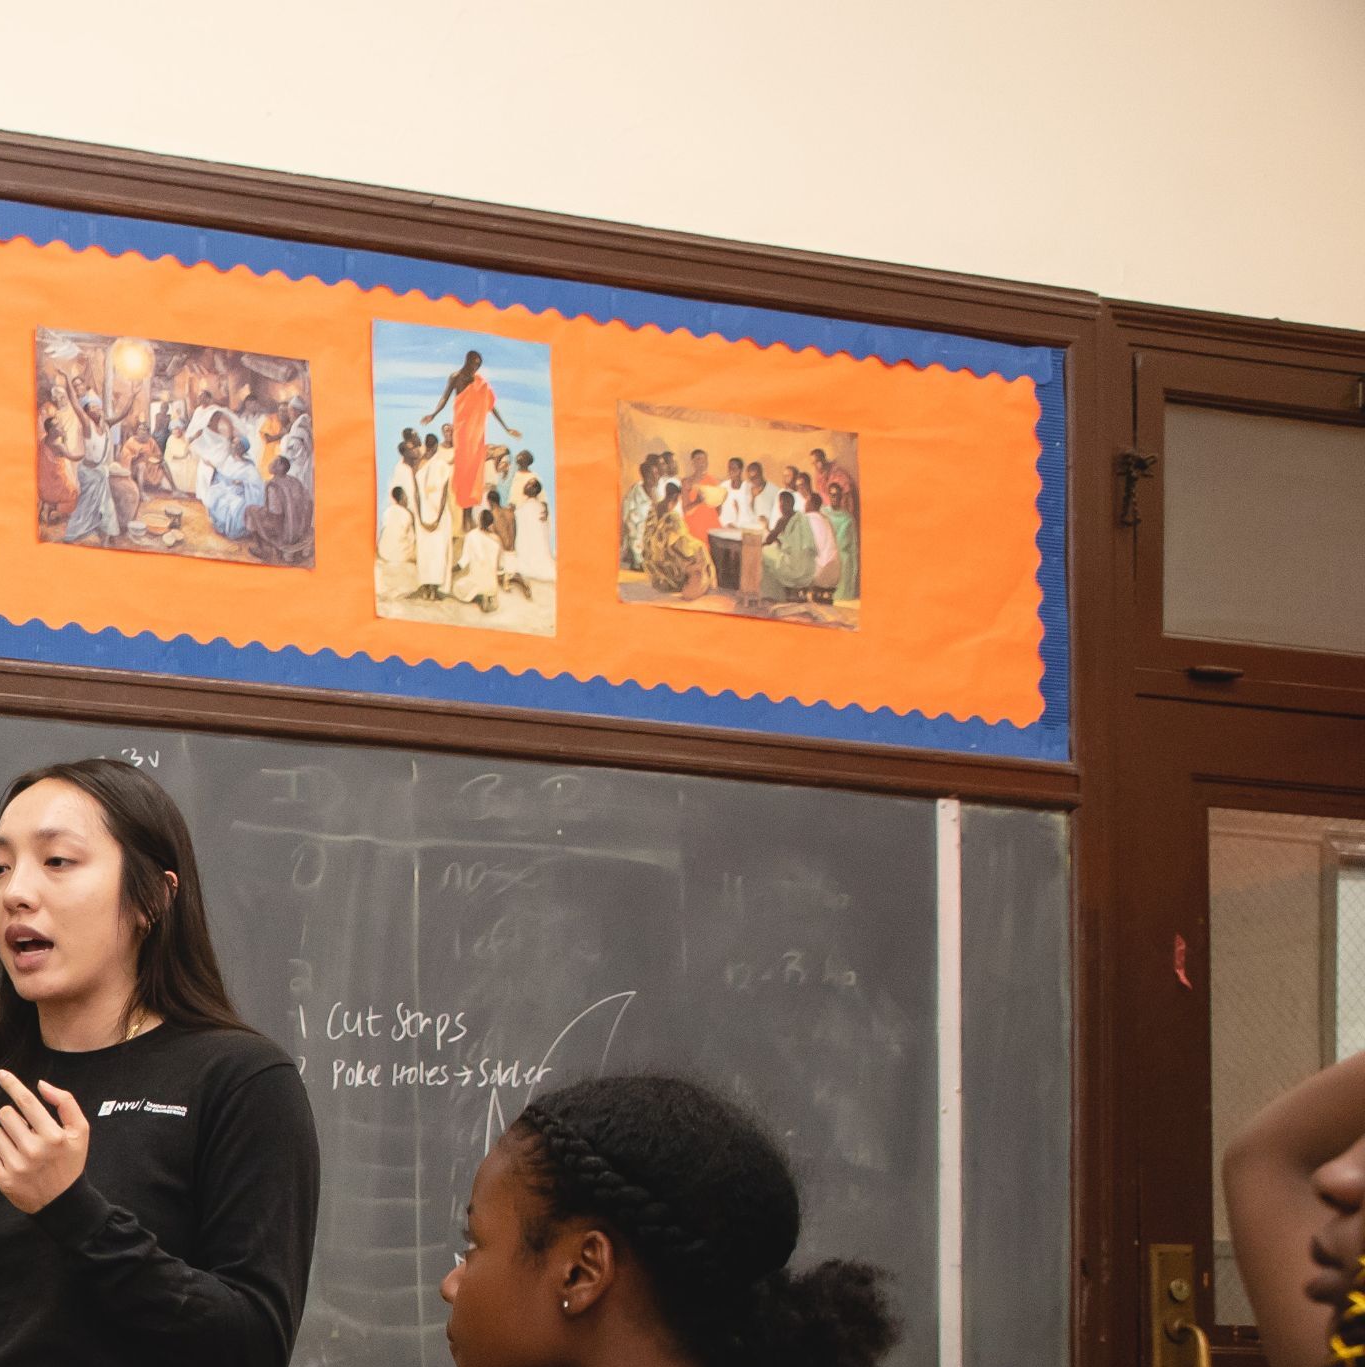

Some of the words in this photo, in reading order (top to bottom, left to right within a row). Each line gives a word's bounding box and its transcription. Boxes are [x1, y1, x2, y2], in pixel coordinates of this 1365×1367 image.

[326, 1001, 384, 1041] Cut
[332, 1059, 382, 1091] Poke
[392, 1060, 450, 1087] Holes
[113, 1100, 141, 1112] NYU
